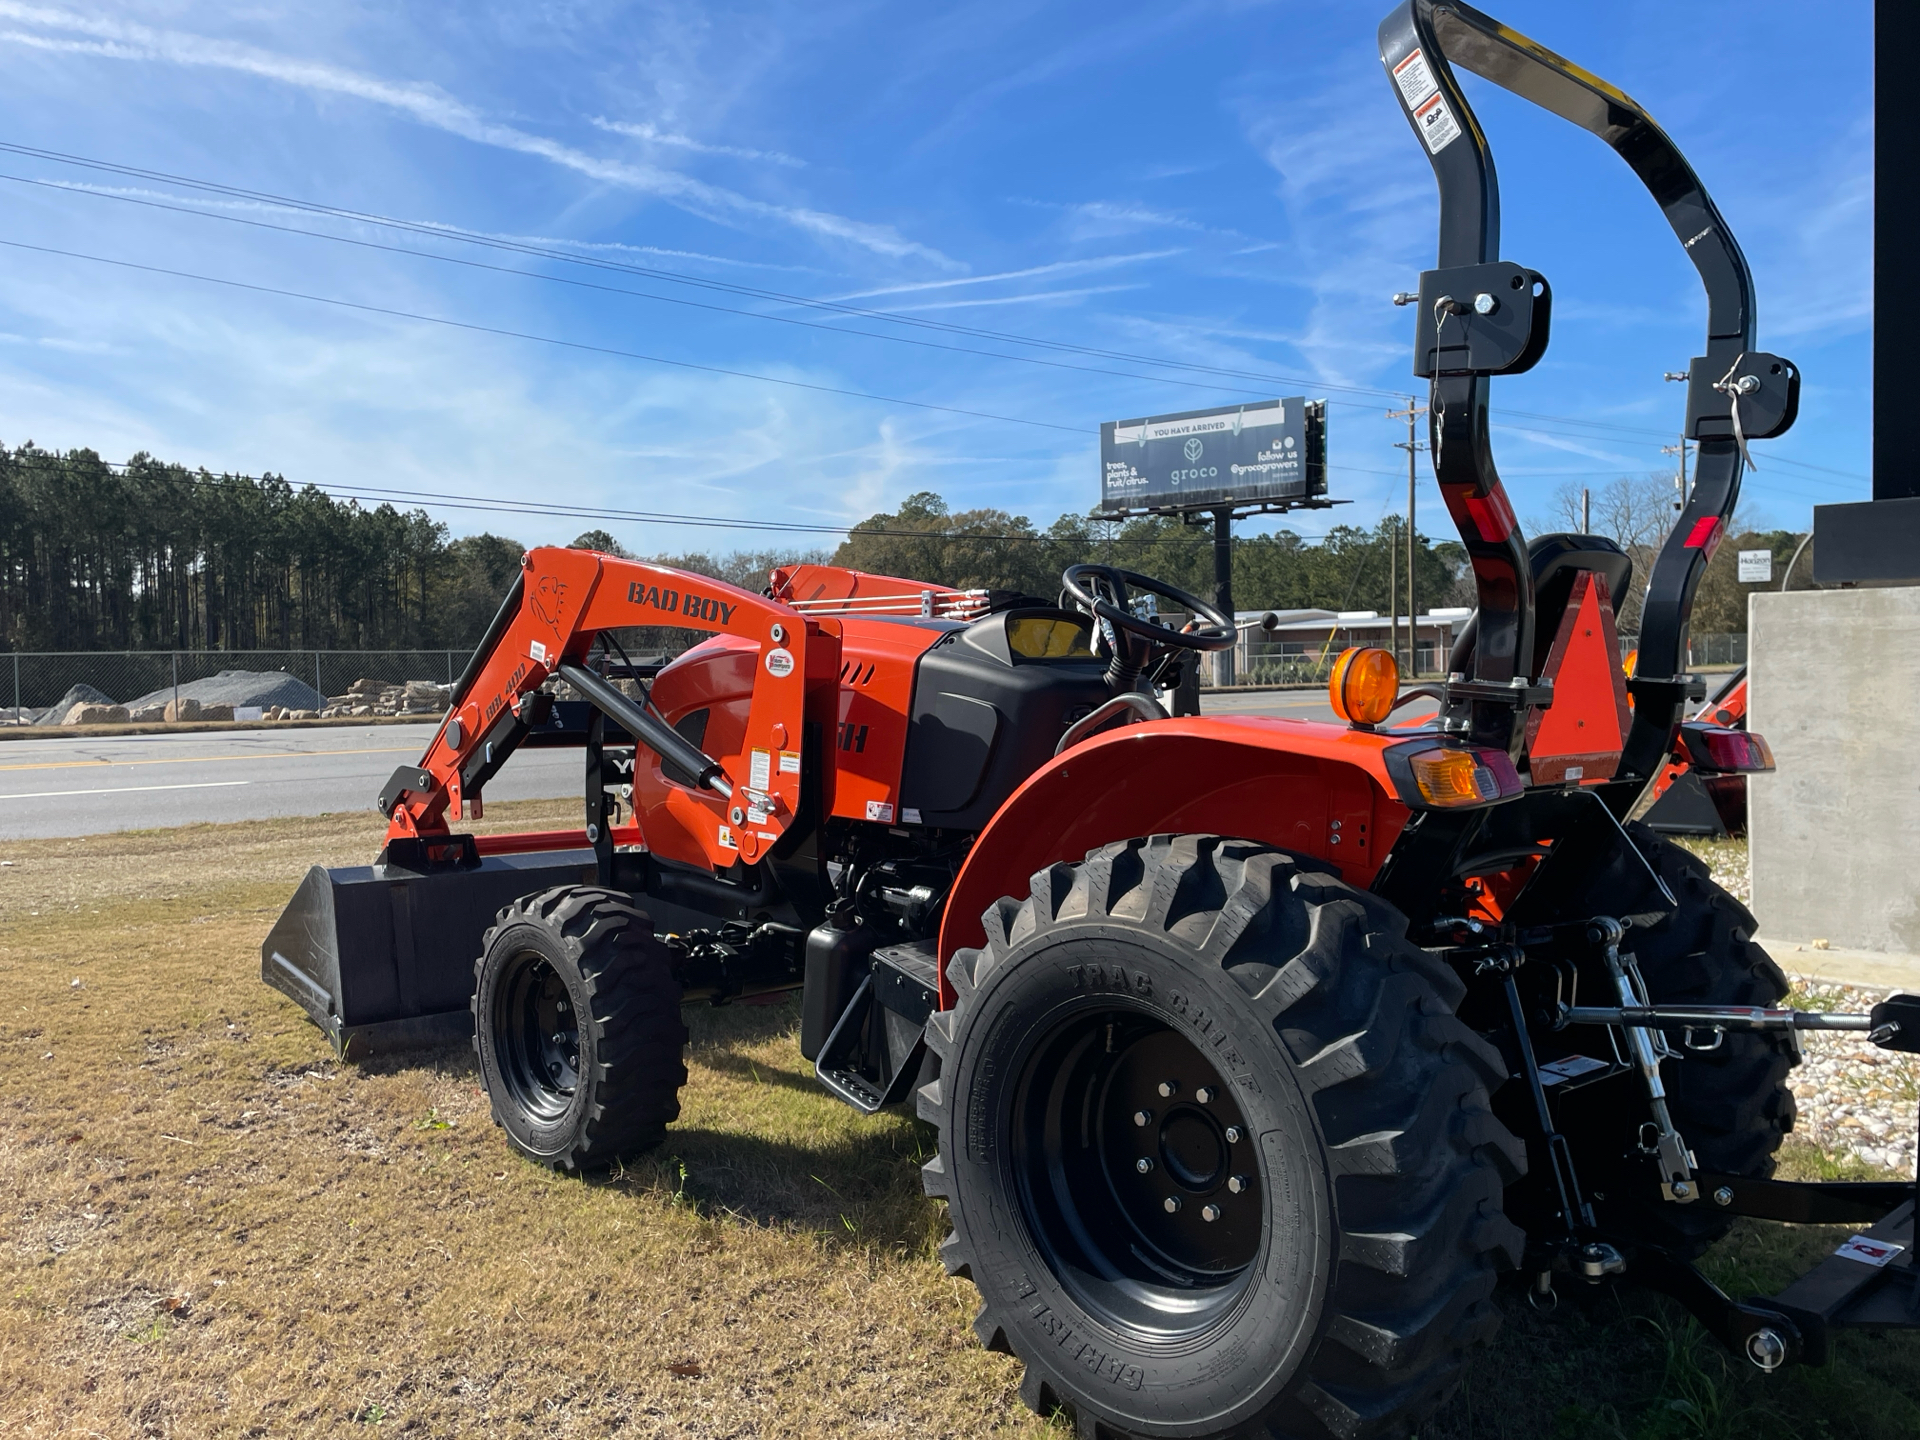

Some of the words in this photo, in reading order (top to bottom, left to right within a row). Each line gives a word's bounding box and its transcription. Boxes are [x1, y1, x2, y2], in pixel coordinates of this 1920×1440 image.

[1154, 428, 1170, 437] YOU
[1171, 425, 1191, 435] HAVE
[1192, 421, 1226, 432] ARRIVED
[1257, 450, 1285, 462] follow
[1287, 450, 1298, 459] us
[1106, 469, 1130, 480] plants
[1130, 466, 1138, 476] &
[1170, 465, 1218, 486] groco
[1230, 460, 1298, 476] @grocogrowers
[628, 581, 679, 612] BAD
[682, 593, 738, 626] BOY
[504, 662, 527, 695] 400
[1066, 963, 1152, 997] TRAC
[1168, 988, 1263, 1098] CHIEF
[1010, 1271, 1144, 1392] CARLISLE
